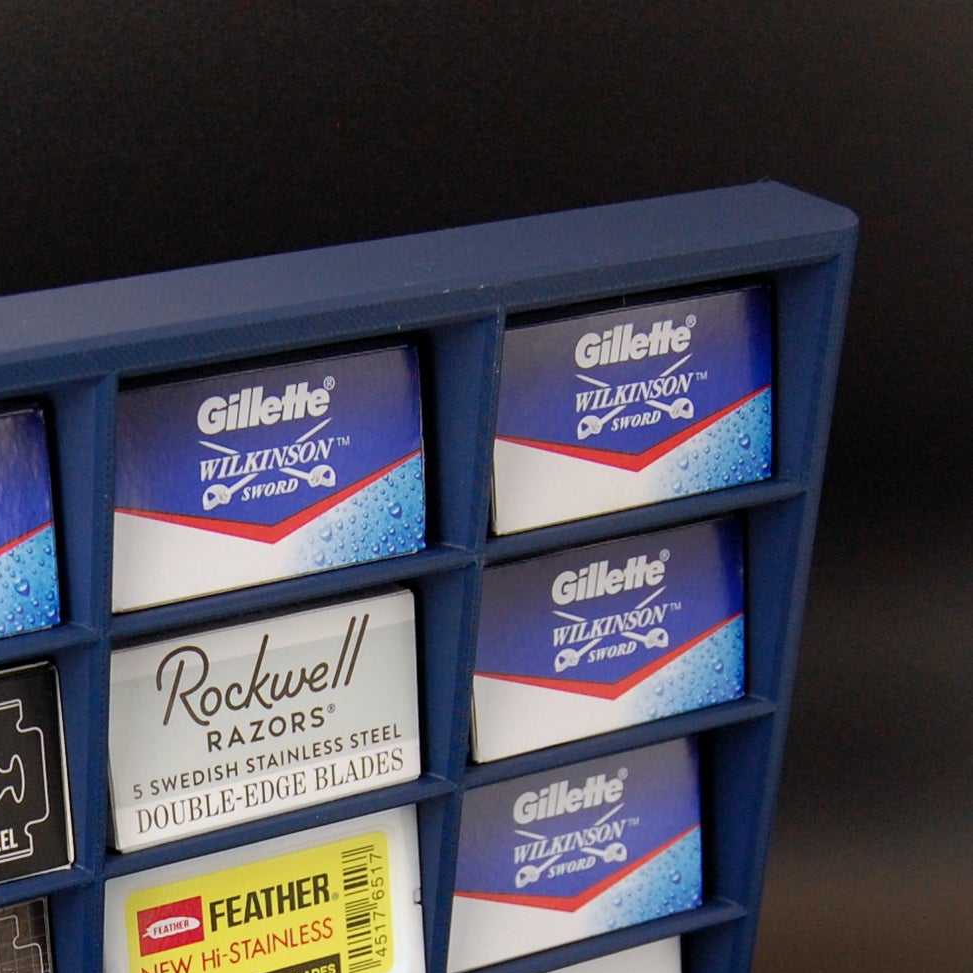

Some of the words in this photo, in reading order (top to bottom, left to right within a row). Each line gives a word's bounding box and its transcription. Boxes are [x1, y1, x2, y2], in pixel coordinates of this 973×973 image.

[575, 320, 692, 368] Gillette
[197, 382, 330, 435] Gillette
[575, 372, 693, 413] WILKINSON
[611, 410, 661, 432] SWORD
[200, 437, 334, 482] WILKINSON
[241, 478, 299, 501] SWORD
[551, 555, 665, 605] Gillette
[553, 604, 668, 647] WILKINSON
[156, 613, 369, 726] Rockwell
[588, 641, 637, 663] SWORD
[207, 706, 325, 752] RAZORS
[134, 784, 142, 799] 5
[150, 762, 239, 795] SWEDISH
[246, 736, 343, 774] STAINLESS
[350, 723, 402, 748] STEEL
[136, 771, 307, 834] DOUBLE-EDGE
[314, 748, 404, 791] BLADES
[513, 774, 623, 824] Gillette
[514, 819, 626, 865] WILKINSON
[547, 857, 596, 879] SWORD
[209, 873, 329, 932] FEATHER
[154, 920, 189, 935] FEATHER
[201, 918, 333, 972] Hi-STAINLESS
